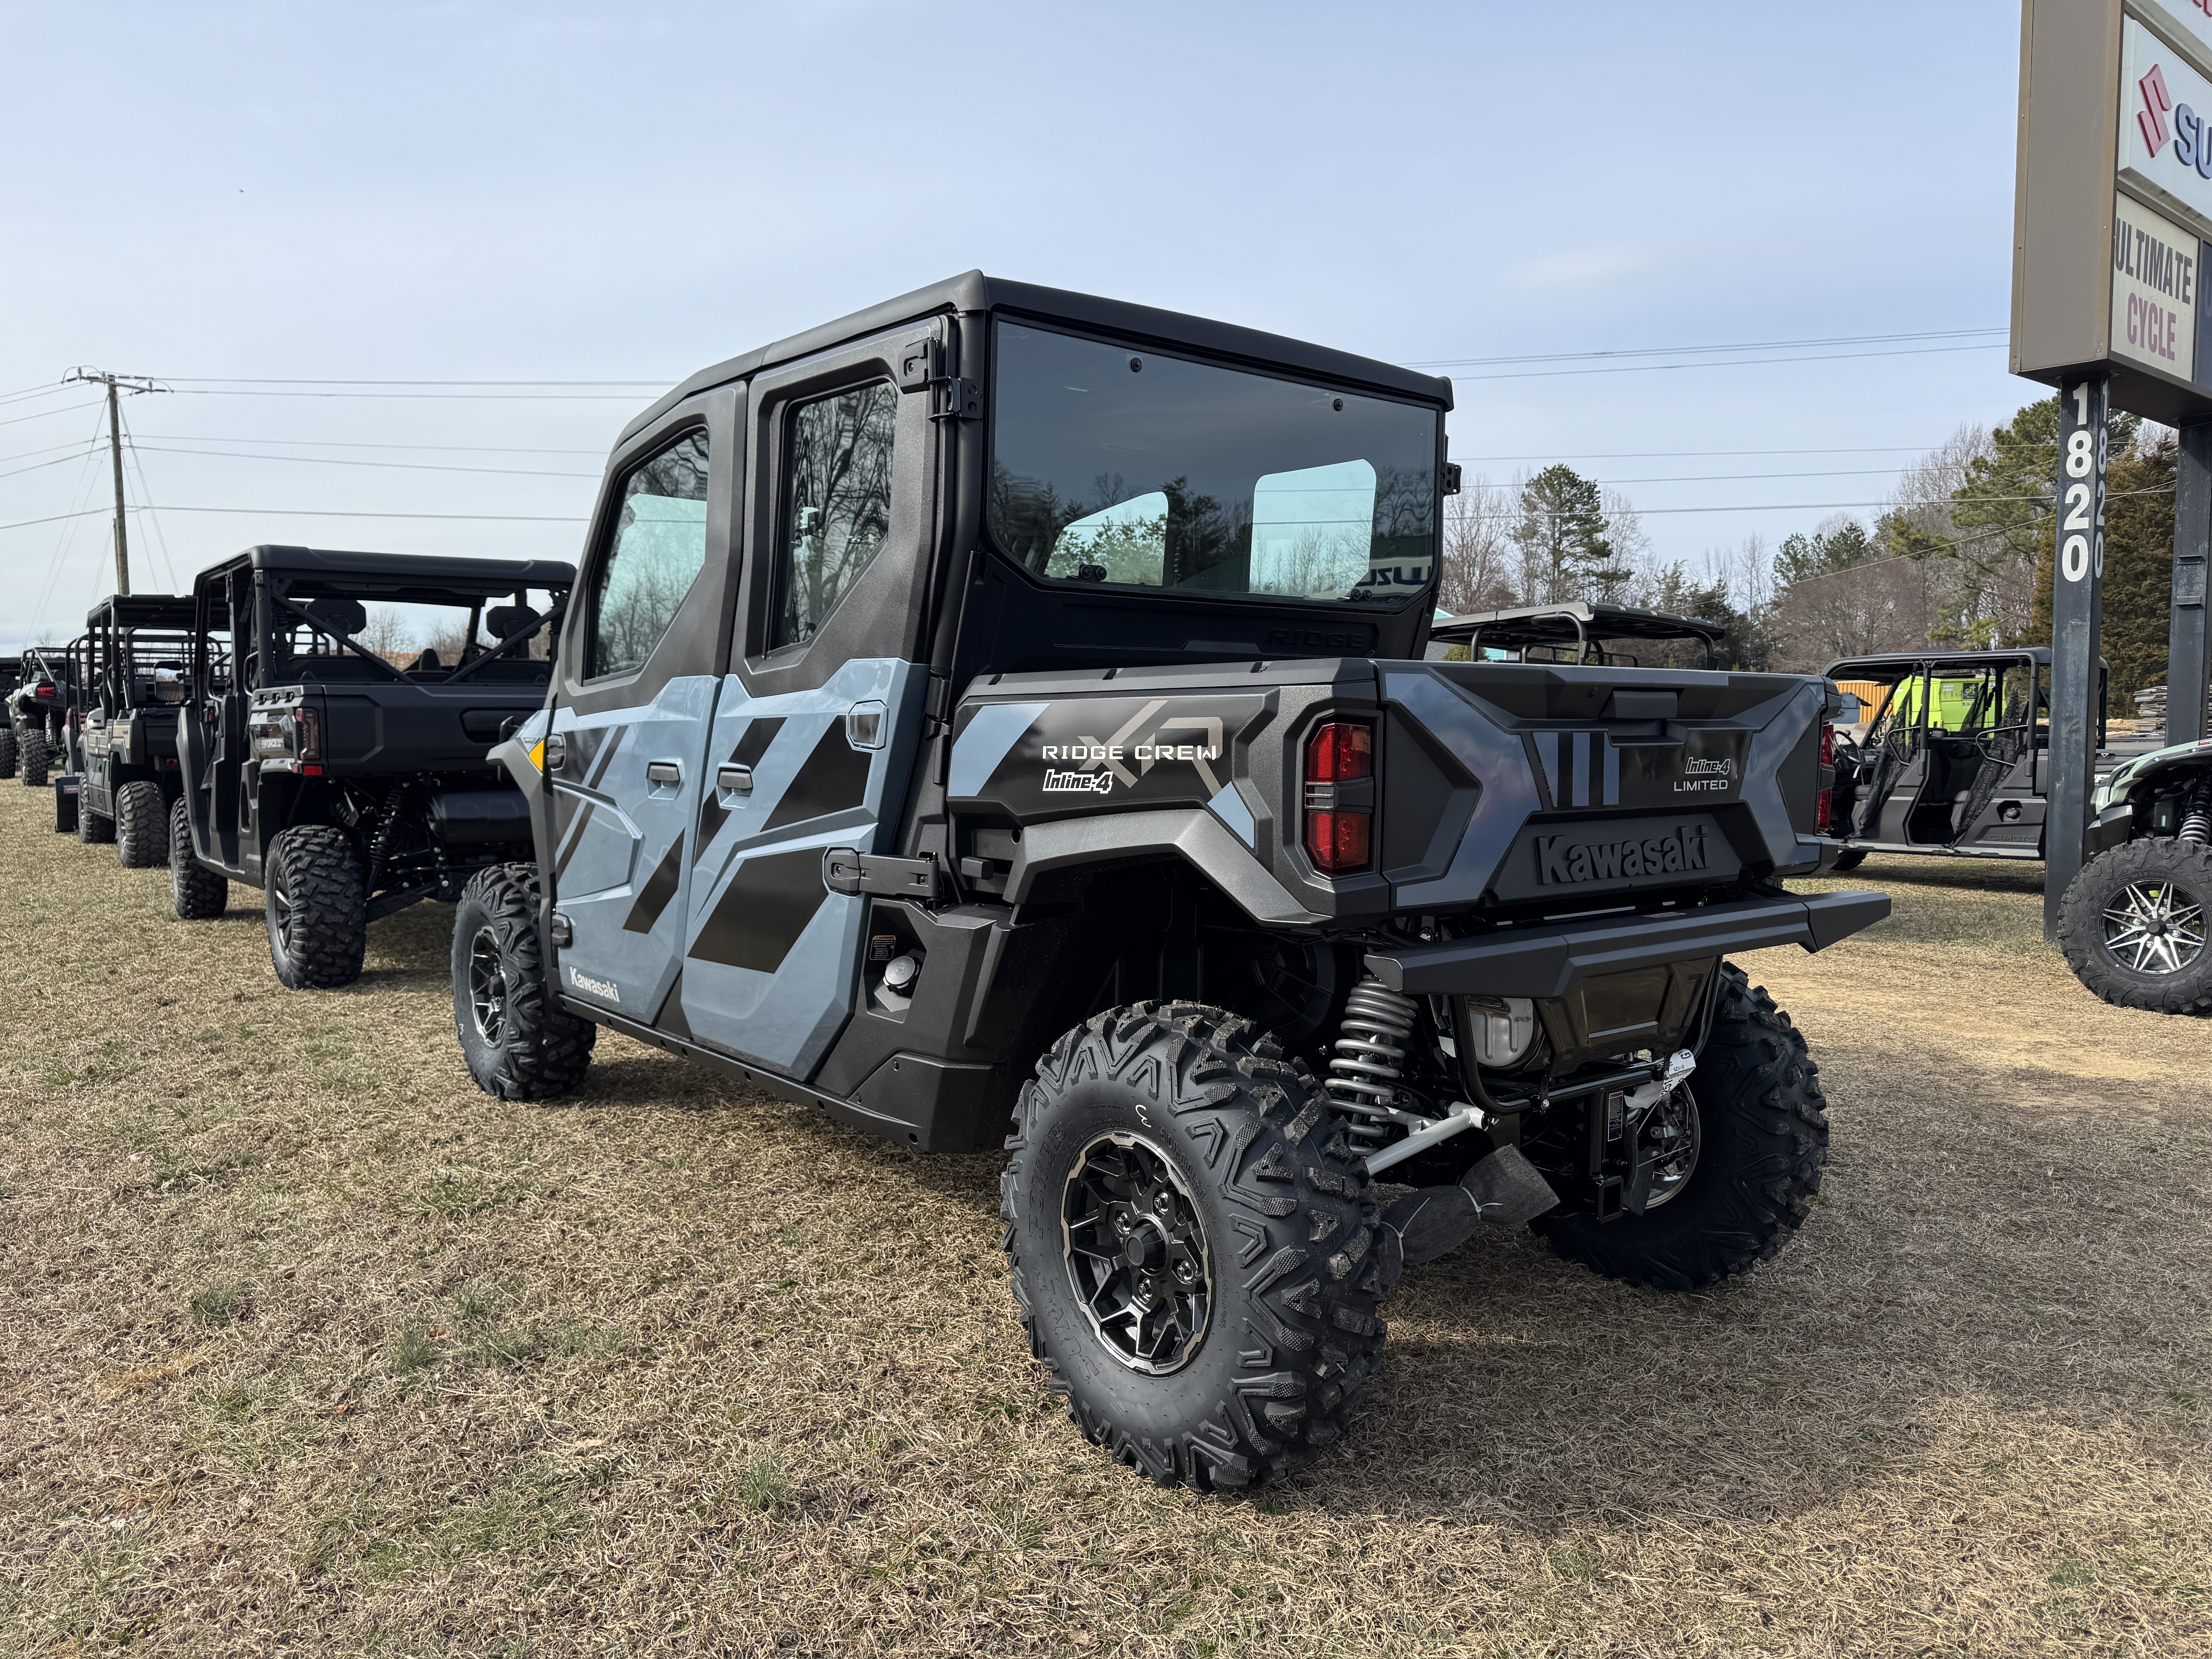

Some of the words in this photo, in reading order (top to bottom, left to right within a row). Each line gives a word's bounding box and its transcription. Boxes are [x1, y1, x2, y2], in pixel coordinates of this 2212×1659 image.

[2115, 217, 2192, 305] ULTIMATE
[2127, 292, 2176, 361] CYCLE
[2062, 382, 2092, 582] 1820
[2095, 378, 2109, 579] 1820
[1267, 628, 1366, 649] RIDGE
[1042, 745, 1123, 760] RIDGE
[1135, 745, 1217, 760] CREW
[1685, 757, 1731, 775] Inline-4
[1042, 769, 1113, 794] Inline-4
[1674, 780, 1728, 792] LIMITED
[1535, 824, 1711, 885] Kawasaki
[570, 967, 620, 1002] Kawasaki
[1029, 1121, 1066, 1242] POWER
